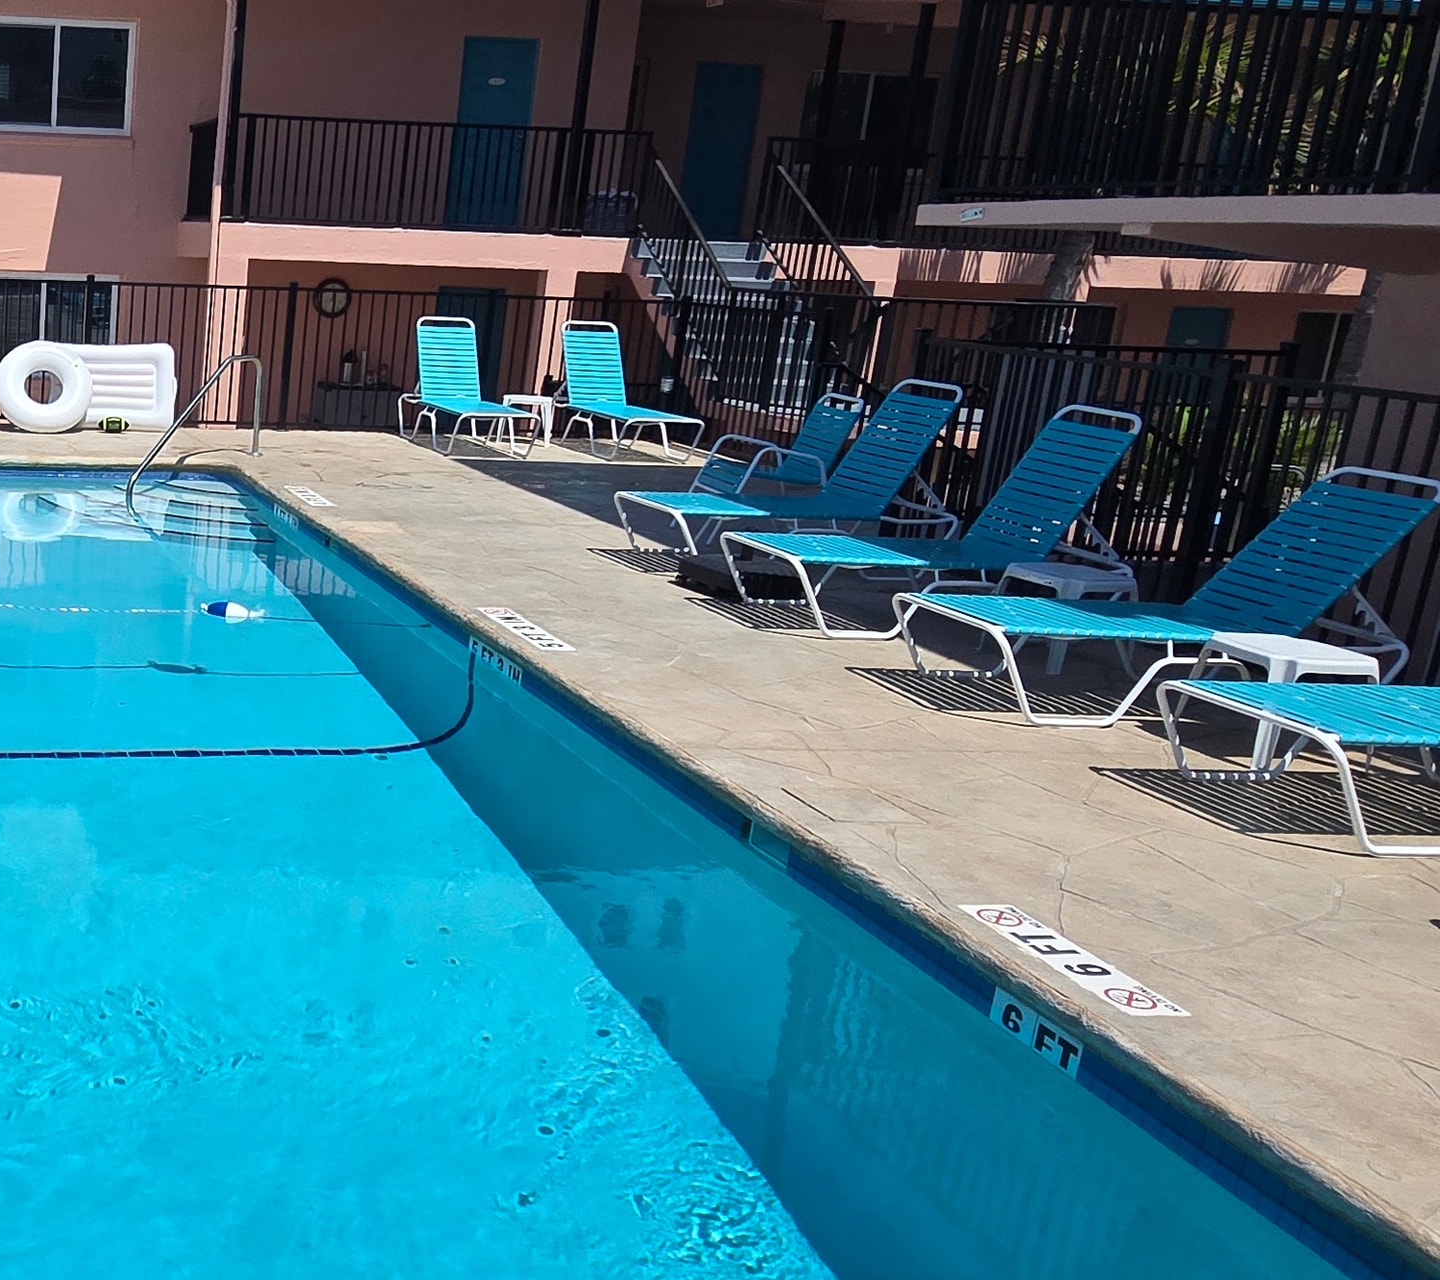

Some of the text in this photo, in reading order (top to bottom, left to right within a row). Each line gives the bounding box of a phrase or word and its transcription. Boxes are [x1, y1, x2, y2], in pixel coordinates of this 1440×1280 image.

[1009, 932, 1112, 977] 6 FT
[1001, 1003, 1079, 1071] 6 FT
